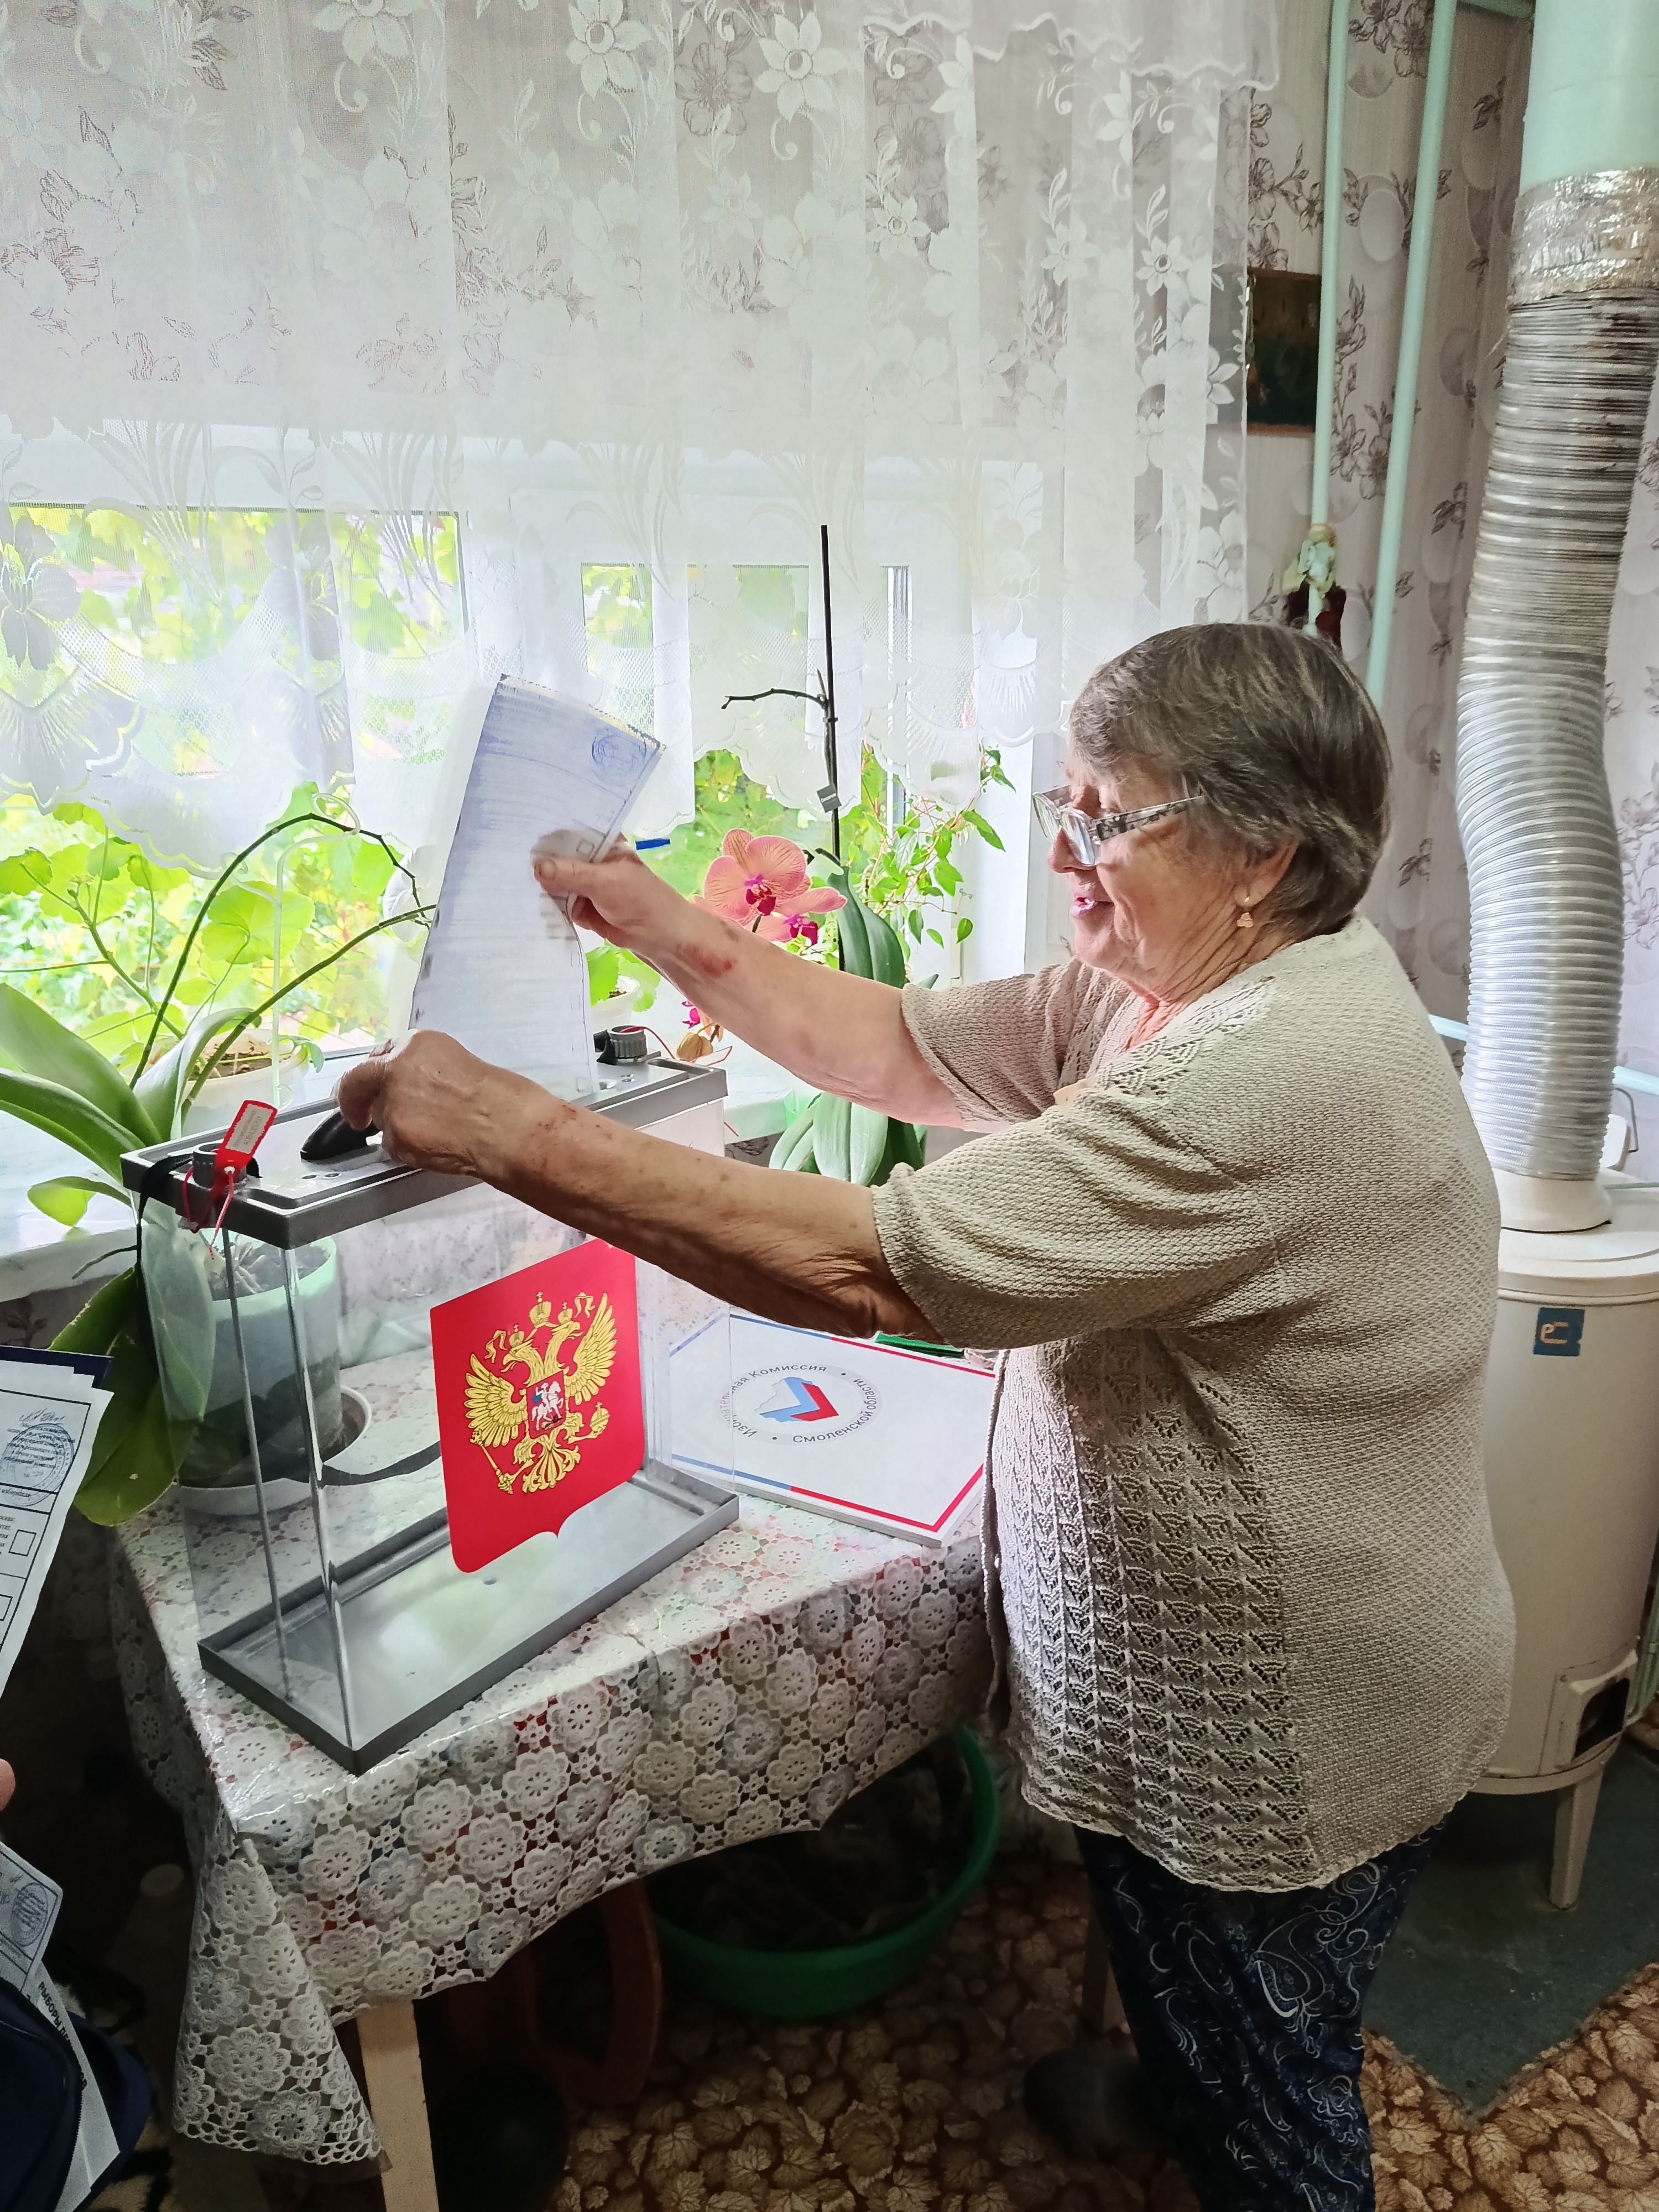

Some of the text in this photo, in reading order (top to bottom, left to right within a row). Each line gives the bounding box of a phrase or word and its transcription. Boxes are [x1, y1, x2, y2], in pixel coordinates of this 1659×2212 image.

[749, 1365, 826, 1378] Комиссия
[793, 1379, 877, 1443] Смоленской области
